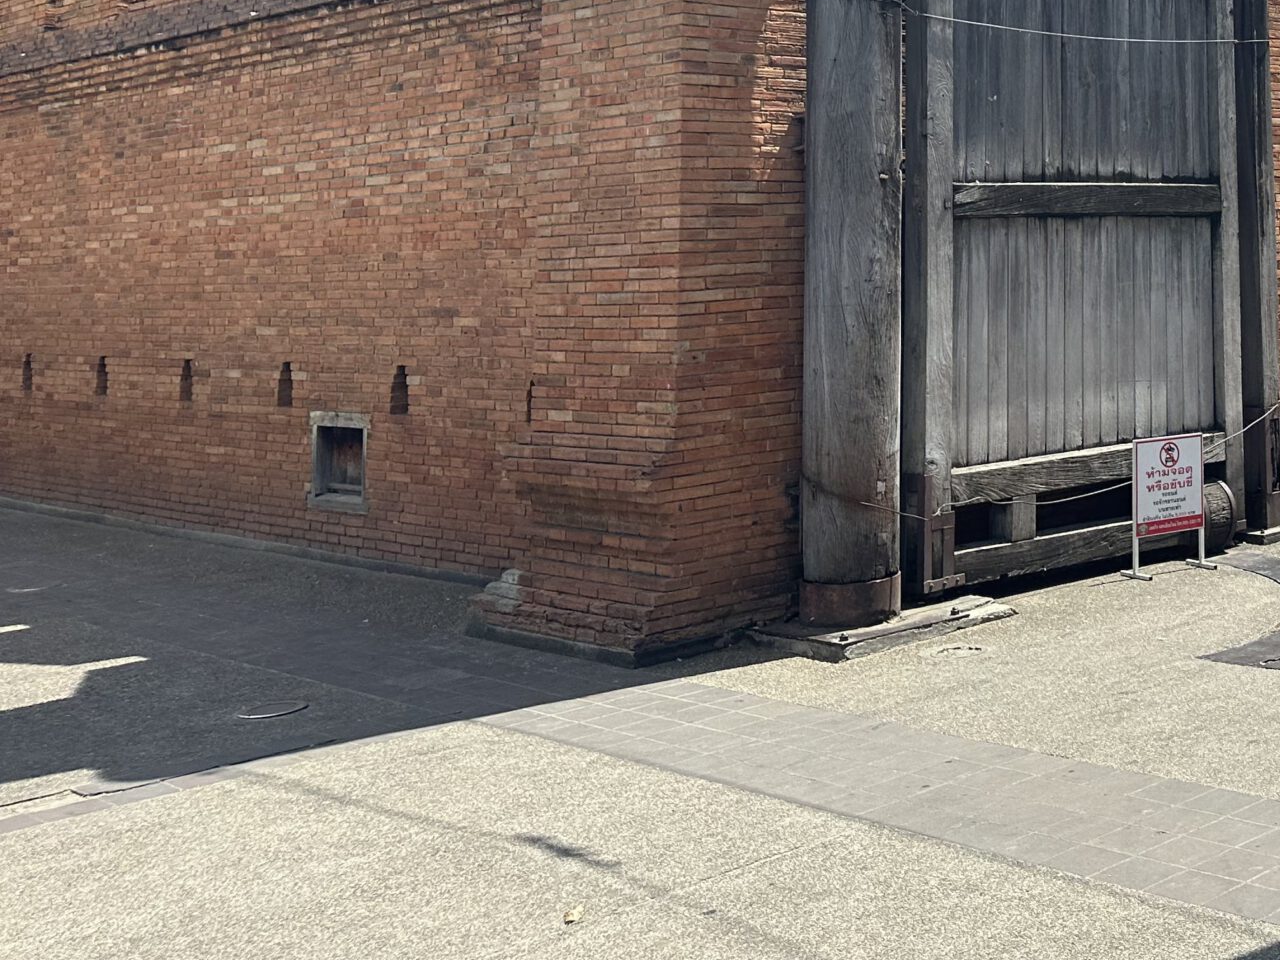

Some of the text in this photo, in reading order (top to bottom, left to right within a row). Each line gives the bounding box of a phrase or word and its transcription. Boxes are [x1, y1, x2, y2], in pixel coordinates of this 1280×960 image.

[1146, 466, 1193, 479] ห้ามจอด
[1146, 476, 1193, 492] หรือขับขี่
